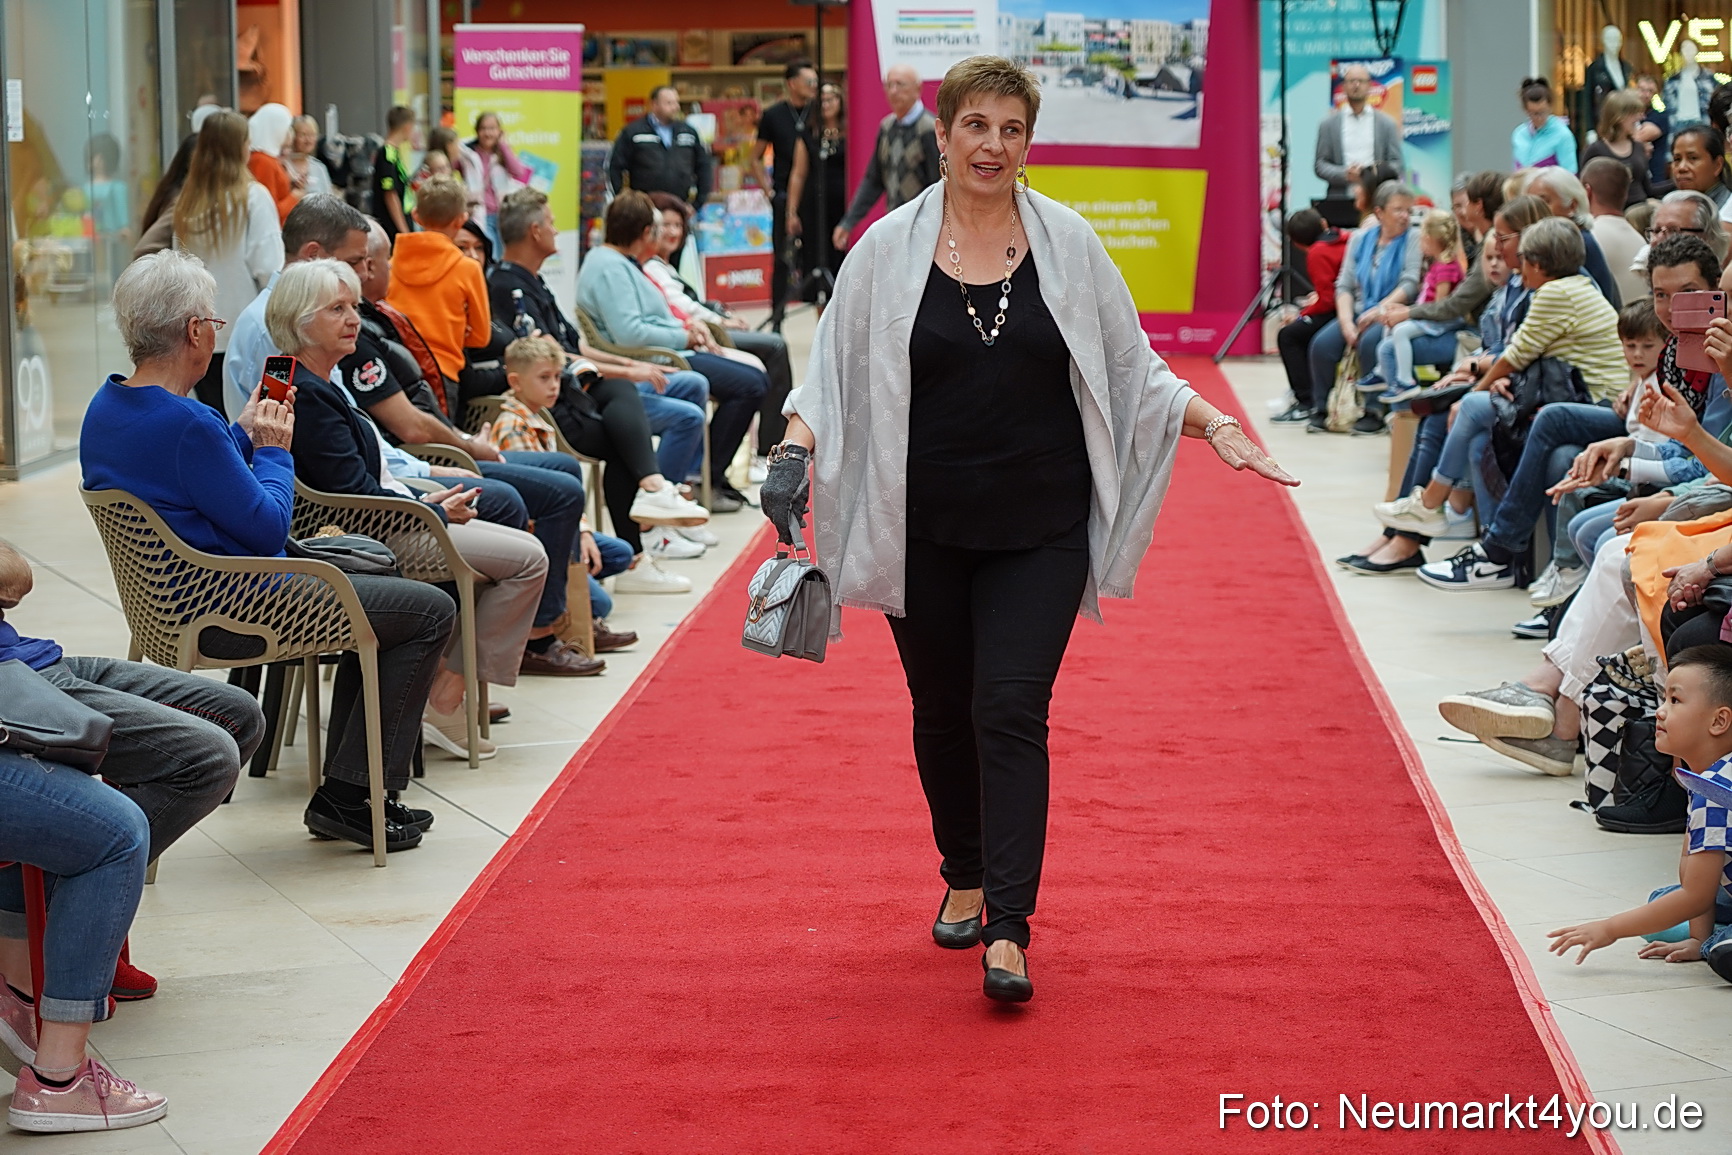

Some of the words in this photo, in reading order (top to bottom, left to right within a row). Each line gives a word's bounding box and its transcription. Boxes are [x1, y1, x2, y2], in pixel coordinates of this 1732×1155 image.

[1638, 19, 1732, 64] VE
[461, 47, 545, 64] Verschenken
[547, 47, 571, 63] Sie
[489, 64, 570, 80] Gutscheine!
[1094, 199, 1134, 213] einem
[1136, 199, 1158, 214] Ort
[1119, 218, 1170, 231] machen
[1107, 235, 1159, 249] buchen.
